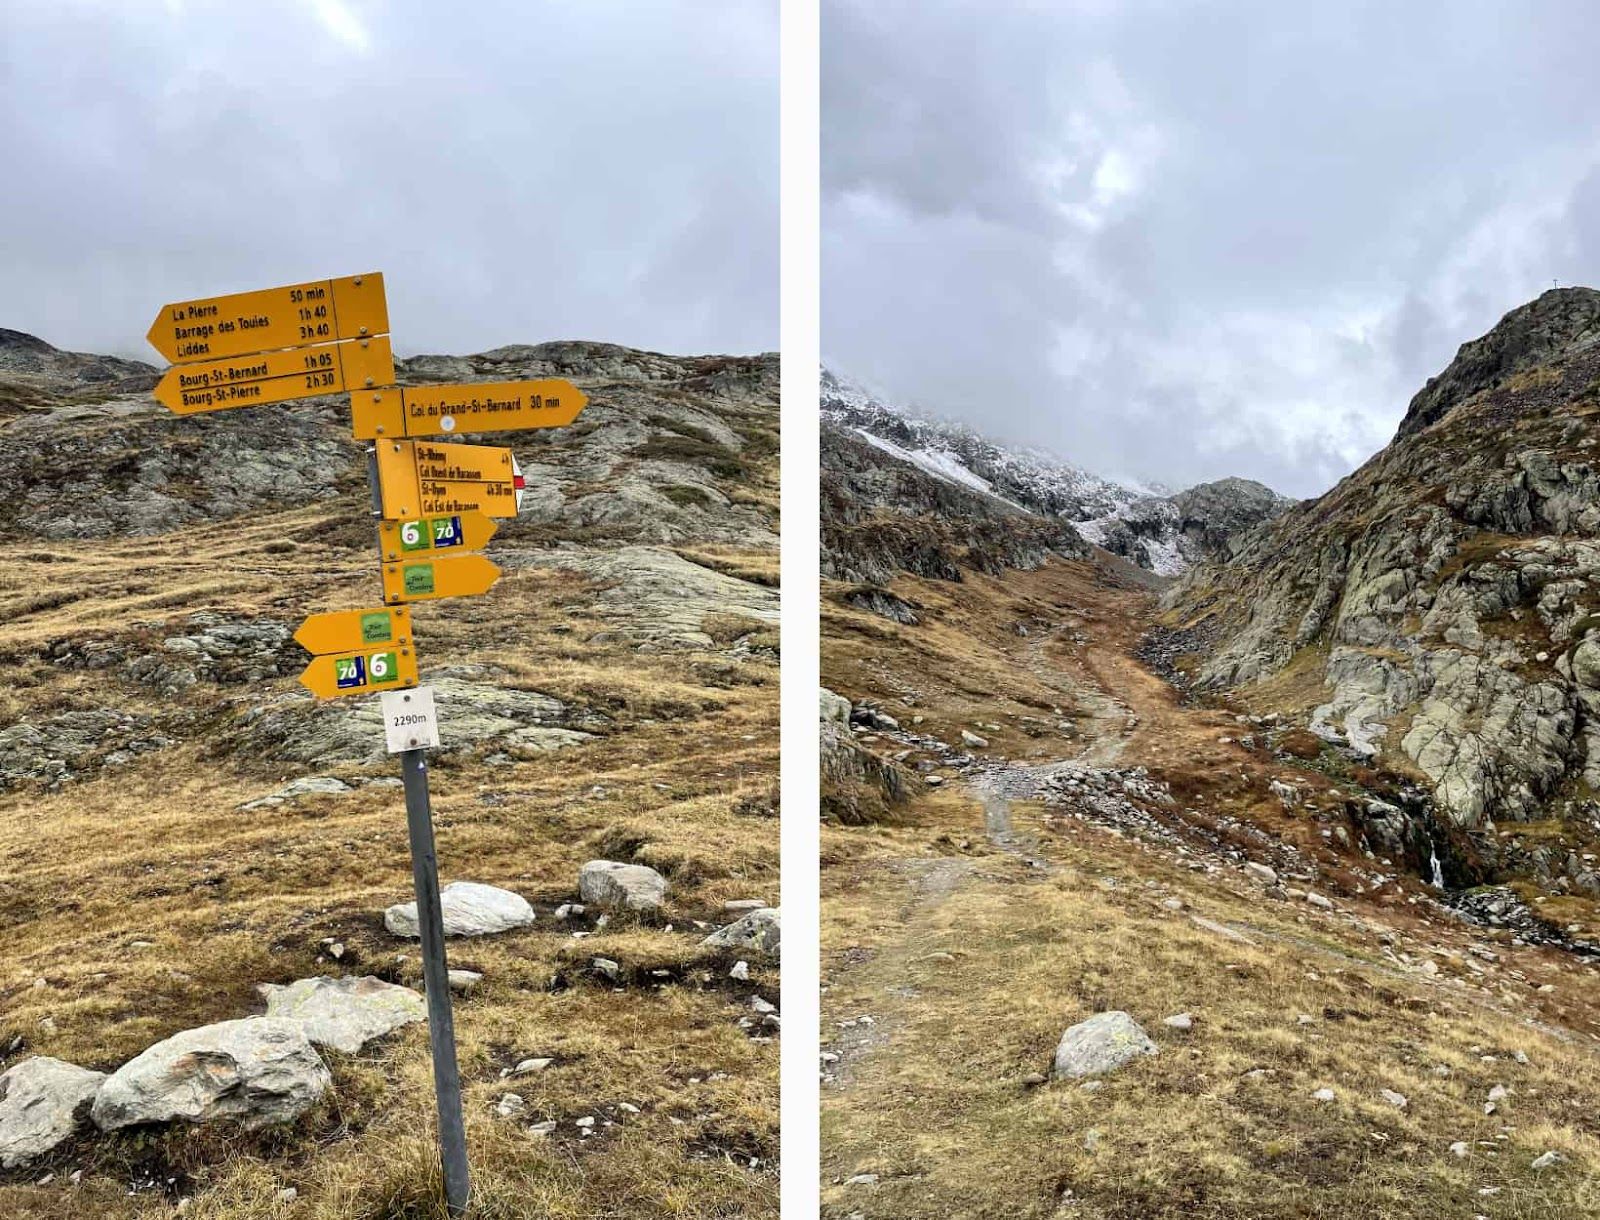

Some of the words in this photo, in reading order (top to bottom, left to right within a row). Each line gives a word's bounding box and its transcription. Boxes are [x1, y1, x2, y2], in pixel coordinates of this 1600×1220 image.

[173, 310, 185, 321] La
[188, 304, 218, 320] Pierre
[290, 290, 302, 302] 50
[306, 287, 325, 300] min
[175, 324, 214, 340] Barrage
[218, 320, 235, 333] des
[314, 305, 327, 318] 40
[177, 342, 210, 358] Liddes
[317, 323, 329, 336] 40
[179, 362, 268, 386] Bourg-St-Bernard
[319, 353, 332, 366] 05
[182, 384, 261, 406] Bourg-St-Pierre
[322, 372, 335, 386] 30
[411, 403, 425, 418] Col
[428, 404, 438, 416] du
[440, 398, 521, 415] Grand-St-Bernard
[530, 395, 542, 409] 30
[545, 396, 560, 409] min
[402, 520, 420, 544] 6
[436, 522, 454, 540] 70
[340, 662, 357, 680] 70
[370, 652, 388, 677] 6
[394, 714, 427, 726] 2290m
